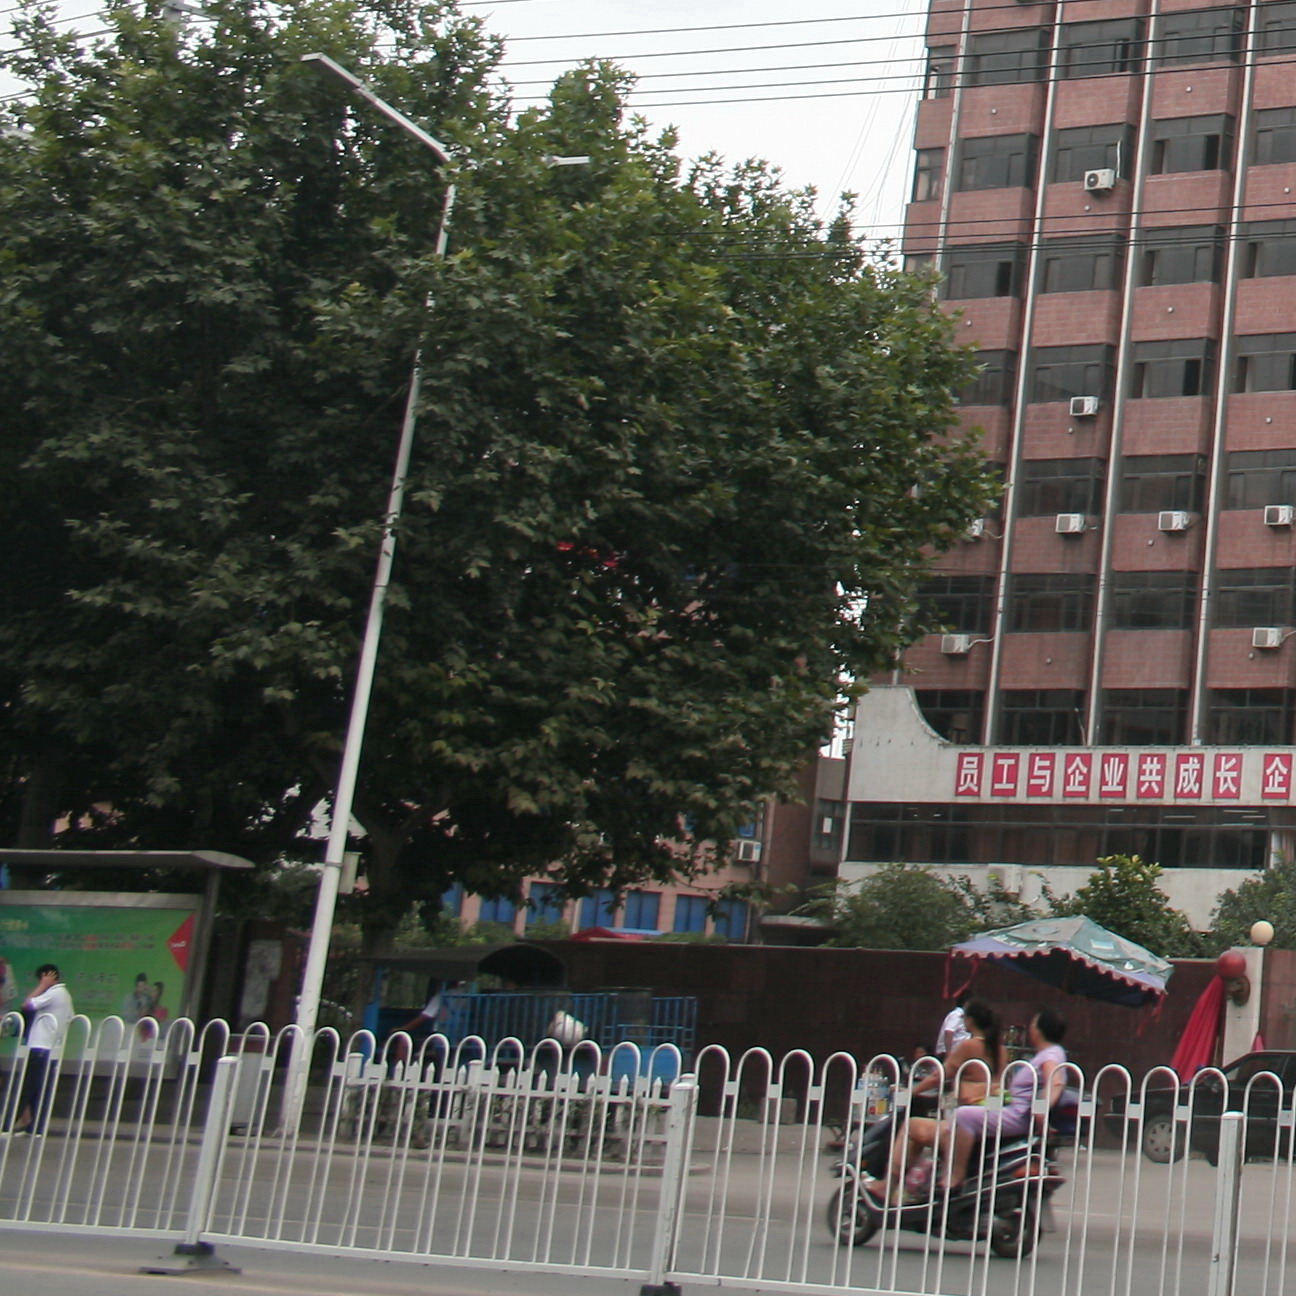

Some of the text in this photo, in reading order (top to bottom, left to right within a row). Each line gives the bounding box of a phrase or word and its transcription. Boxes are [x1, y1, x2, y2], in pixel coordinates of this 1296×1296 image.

[957, 754, 1242, 796] 员工与企业共成长
